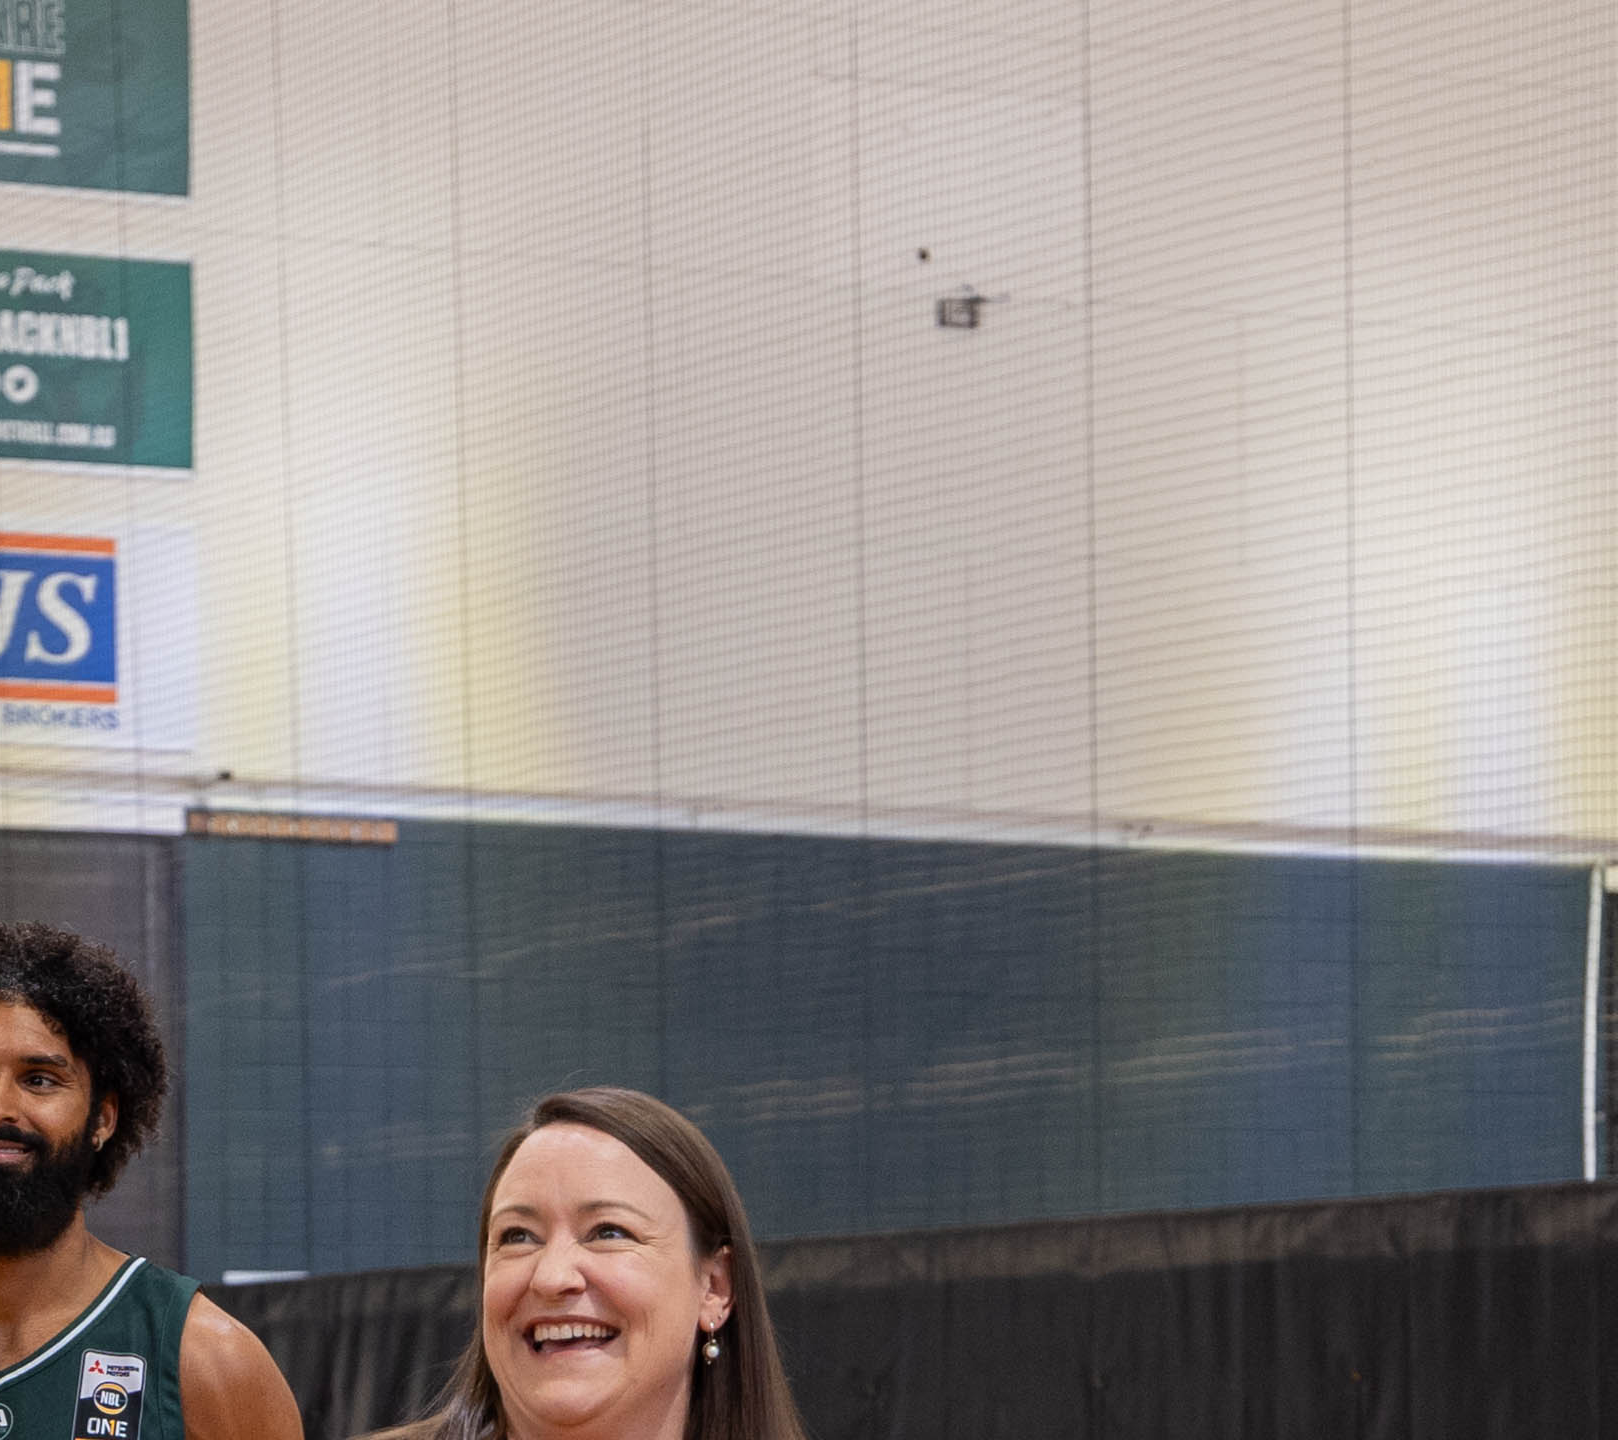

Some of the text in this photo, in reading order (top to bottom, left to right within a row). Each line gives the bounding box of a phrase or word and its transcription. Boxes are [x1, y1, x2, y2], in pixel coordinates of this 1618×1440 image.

[2, 704, 121, 731] BROKERS
[100, 1391, 121, 1407] NBL
[87, 1417, 129, 1438] ONE
